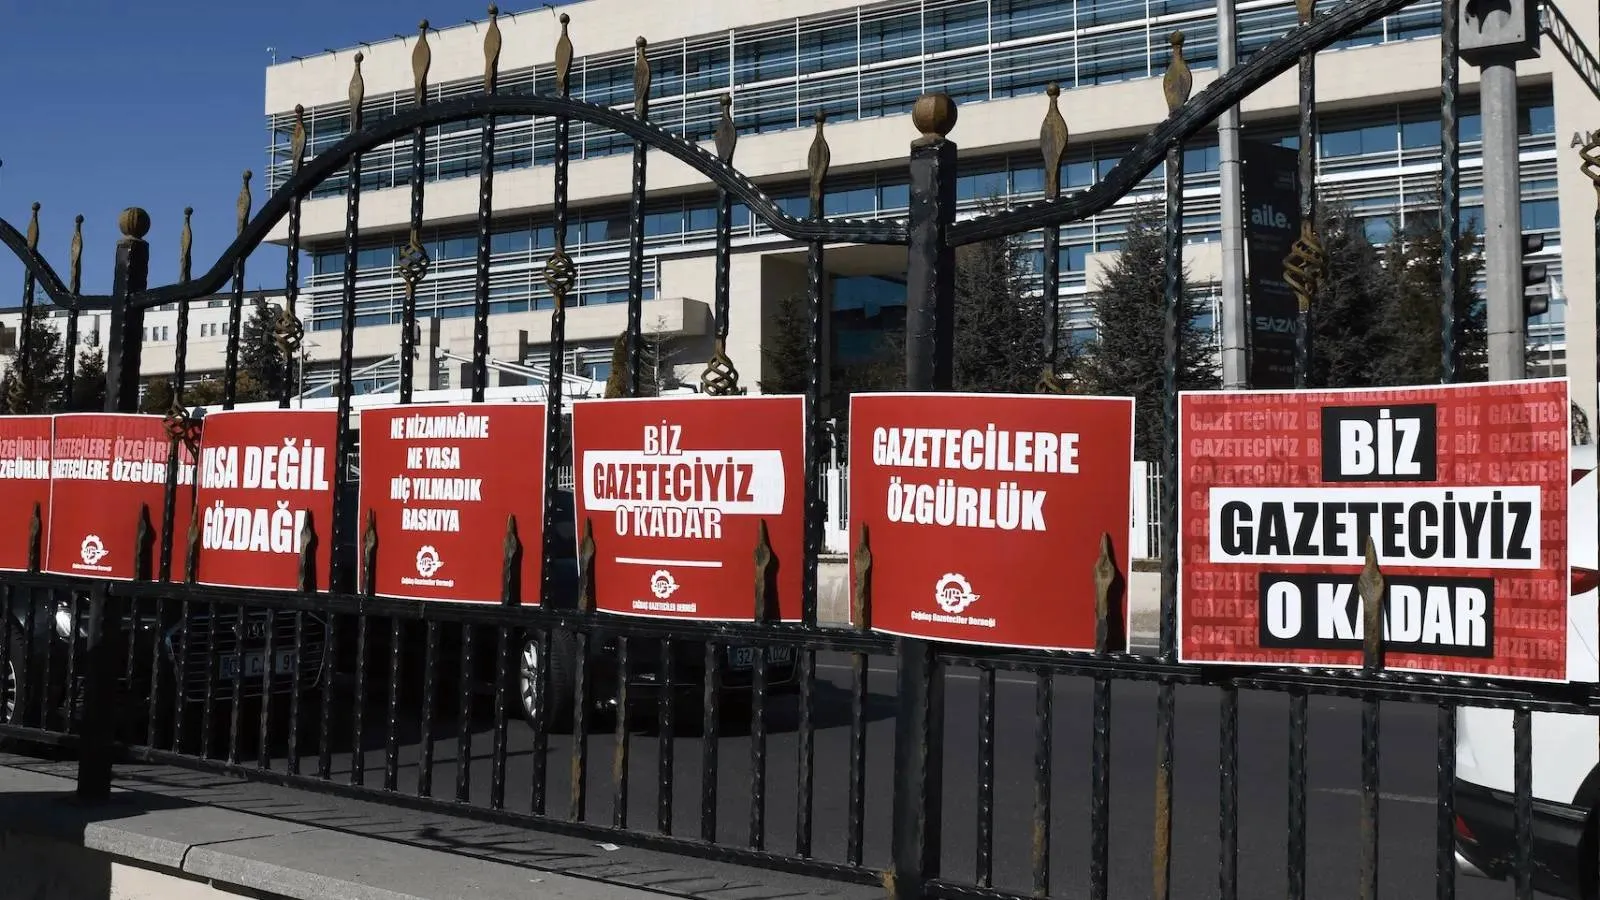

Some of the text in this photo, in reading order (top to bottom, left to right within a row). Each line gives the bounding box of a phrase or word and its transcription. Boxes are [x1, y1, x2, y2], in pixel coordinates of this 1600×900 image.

[1252, 204, 1291, 229] aile.
[390, 411, 490, 440] NE NİZAMNÂME
[1190, 408, 1298, 431] GAZETECİYİZ
[1454, 402, 1481, 427] BİZ
[643, 418, 683, 456] BİZ
[872, 422, 1080, 474] GAZETECİLERE
[1190, 435, 1299, 458] GAZETECİYİZ
[1454, 430, 1481, 454] BİZ
[1339, 408, 1422, 477] BİZ
[242, 437, 330, 491] DEĞİL
[406, 446, 461, 470] NE YASA
[1190, 461, 1299, 484] GAZETECİYİZ
[390, 473, 482, 504] HİÇ YILMADIK
[593, 457, 755, 503] GAZETECİYİZ
[401, 507, 461, 532] BASKIYA
[886, 475, 1048, 532] ÖZGÜRLÜK
[614, 504, 723, 540] O KADAR
[1220, 490, 1532, 560] GAZETECİYİZ
[1266, 580, 1302, 640] O
